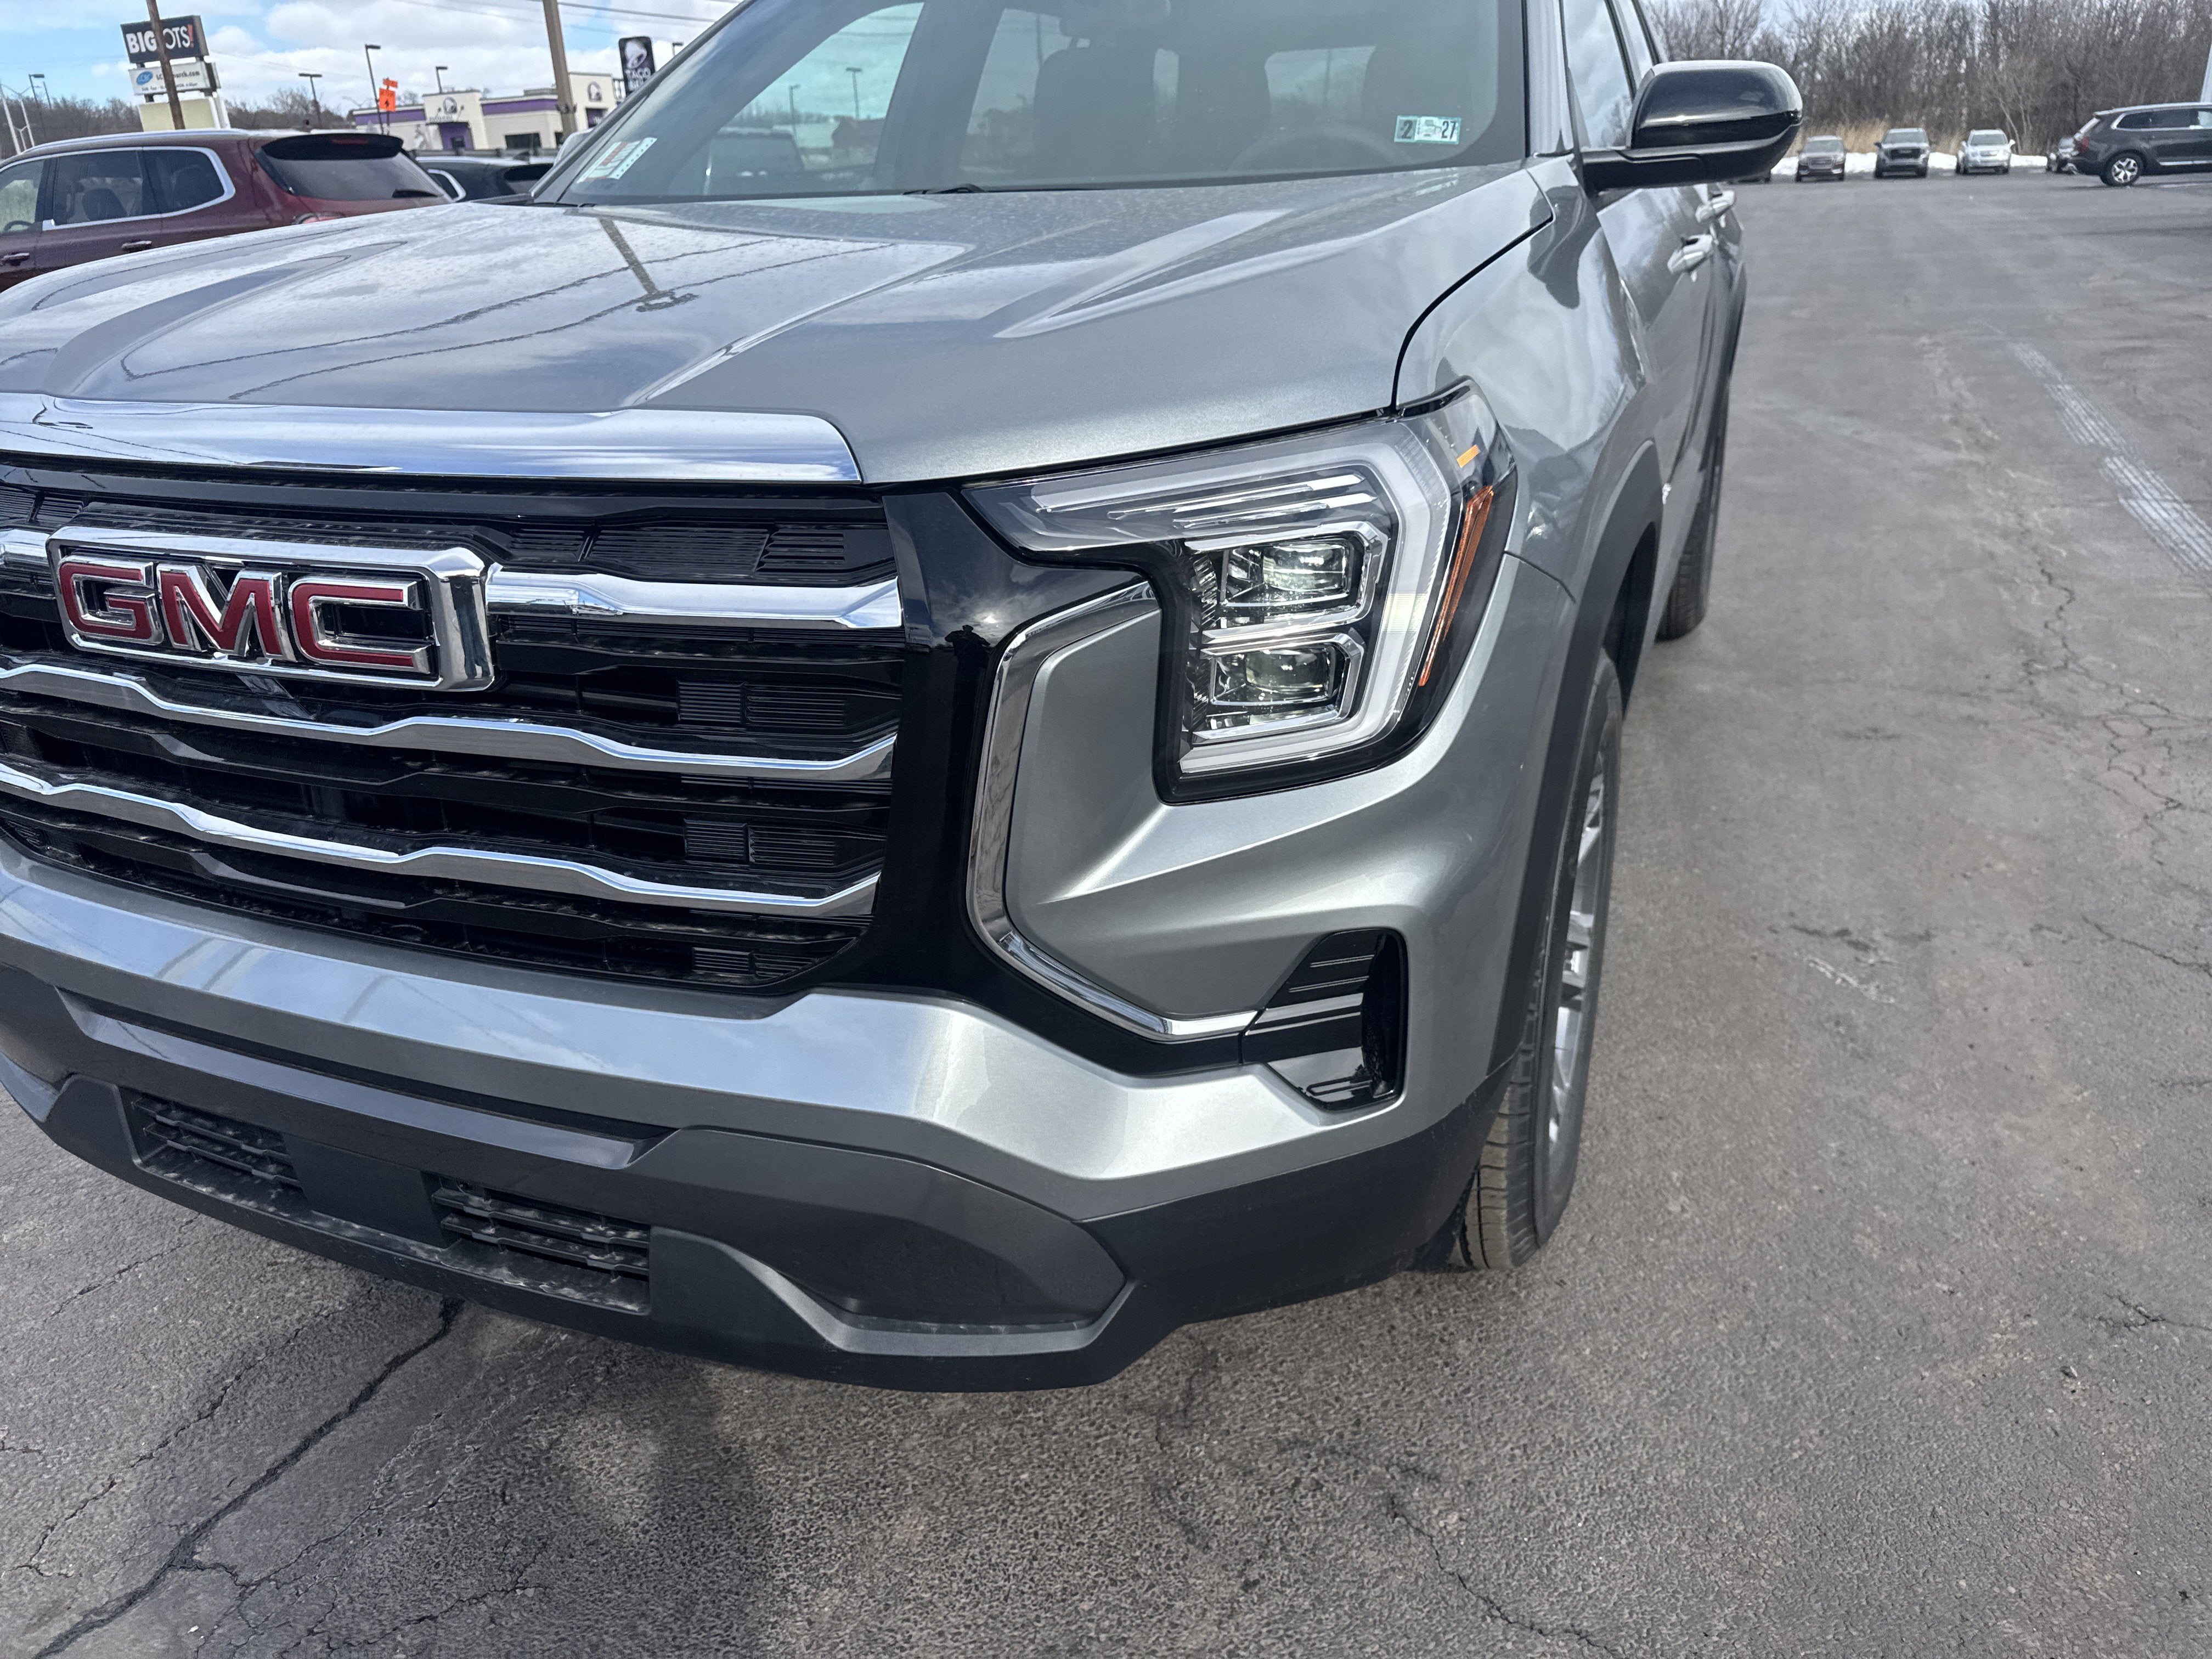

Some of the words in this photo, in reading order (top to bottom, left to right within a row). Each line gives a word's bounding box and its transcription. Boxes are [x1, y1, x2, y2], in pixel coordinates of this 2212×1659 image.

[126, 30, 157, 54] BIG
[162, 24, 194, 50] OTS!
[624, 67, 651, 81] TACO
[1401, 120, 1413, 139] 2
[1441, 120, 1457, 140] 27
[59, 555, 432, 674] GMC
